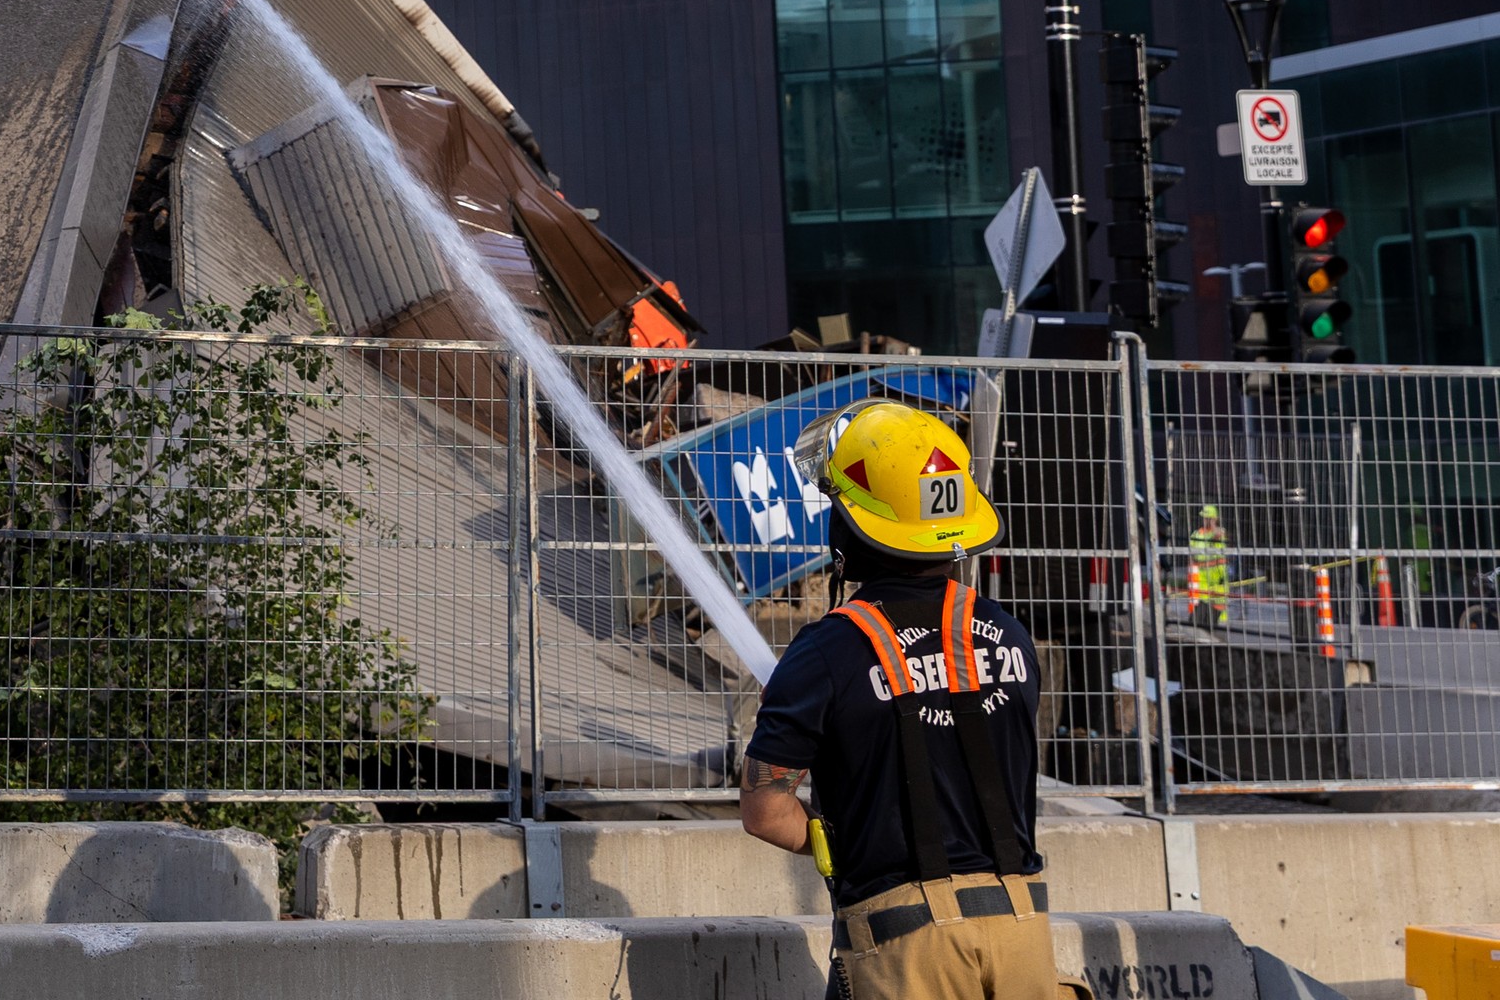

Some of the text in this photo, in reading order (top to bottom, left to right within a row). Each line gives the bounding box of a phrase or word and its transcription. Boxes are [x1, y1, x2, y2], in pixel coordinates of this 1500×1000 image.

[1251, 143, 1294, 155] EXCEPTÉ
[1249, 156, 1299, 166] LIVRAISON
[1256, 168, 1293, 178] LOCALE
[930, 478, 958, 514] 20
[995, 646, 1028, 683] 20
